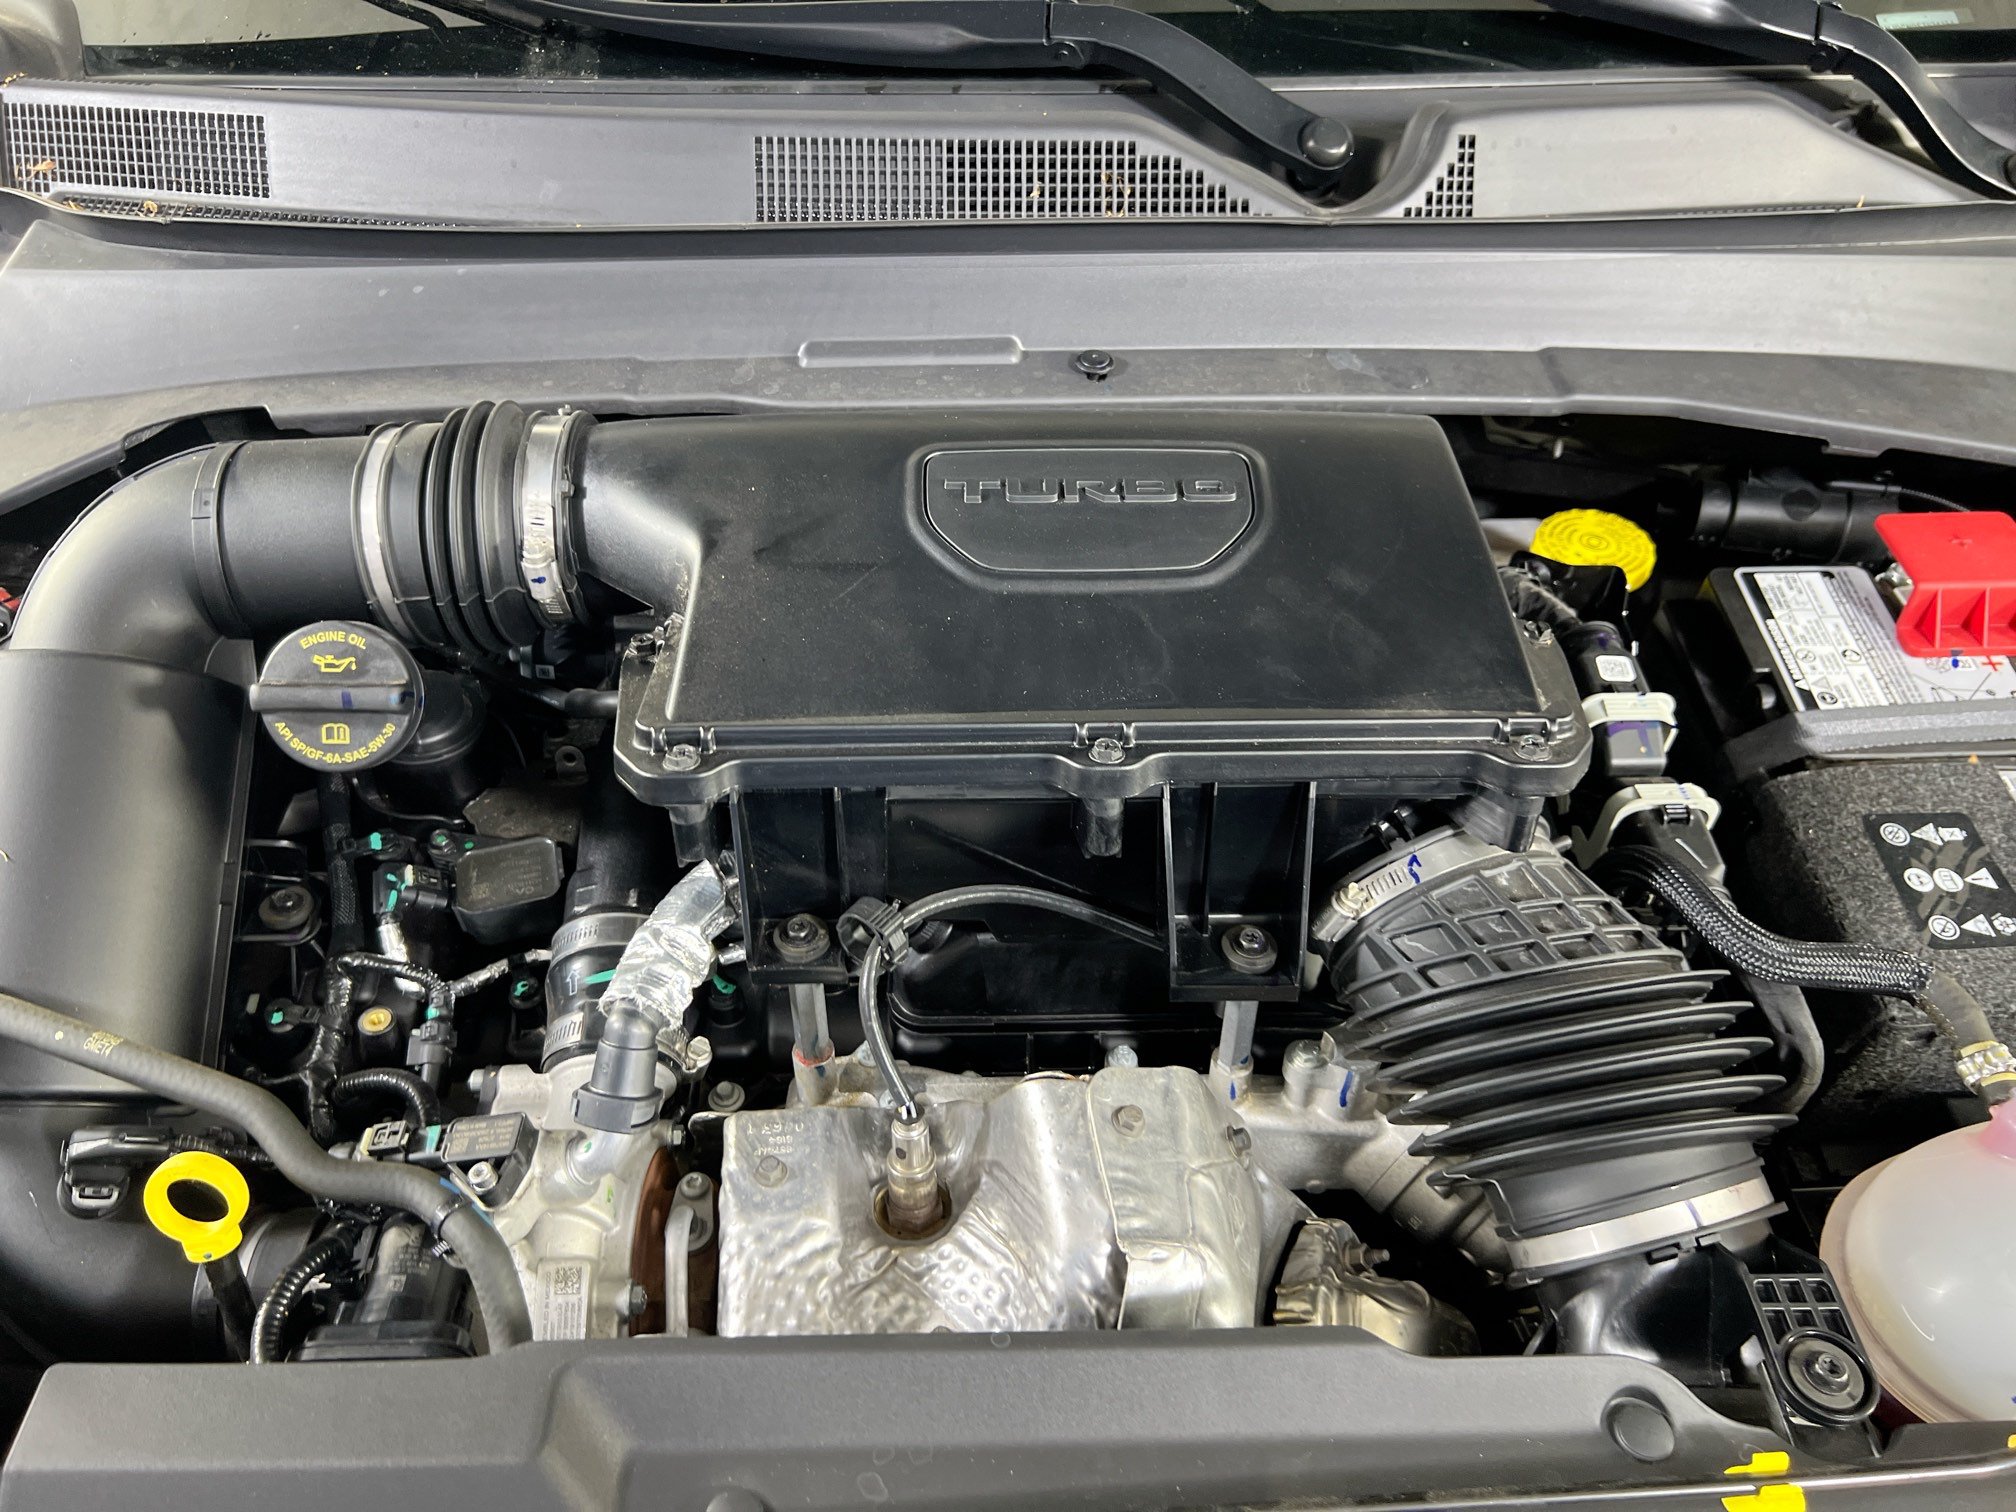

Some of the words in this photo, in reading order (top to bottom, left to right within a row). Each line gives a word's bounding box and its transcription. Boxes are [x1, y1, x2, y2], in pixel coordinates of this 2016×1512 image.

[943, 477, 1239, 505] TURBO
[299, 631, 346, 650] ENGINE
[348, 633, 367, 650] OIL
[275, 721, 293, 742] API
